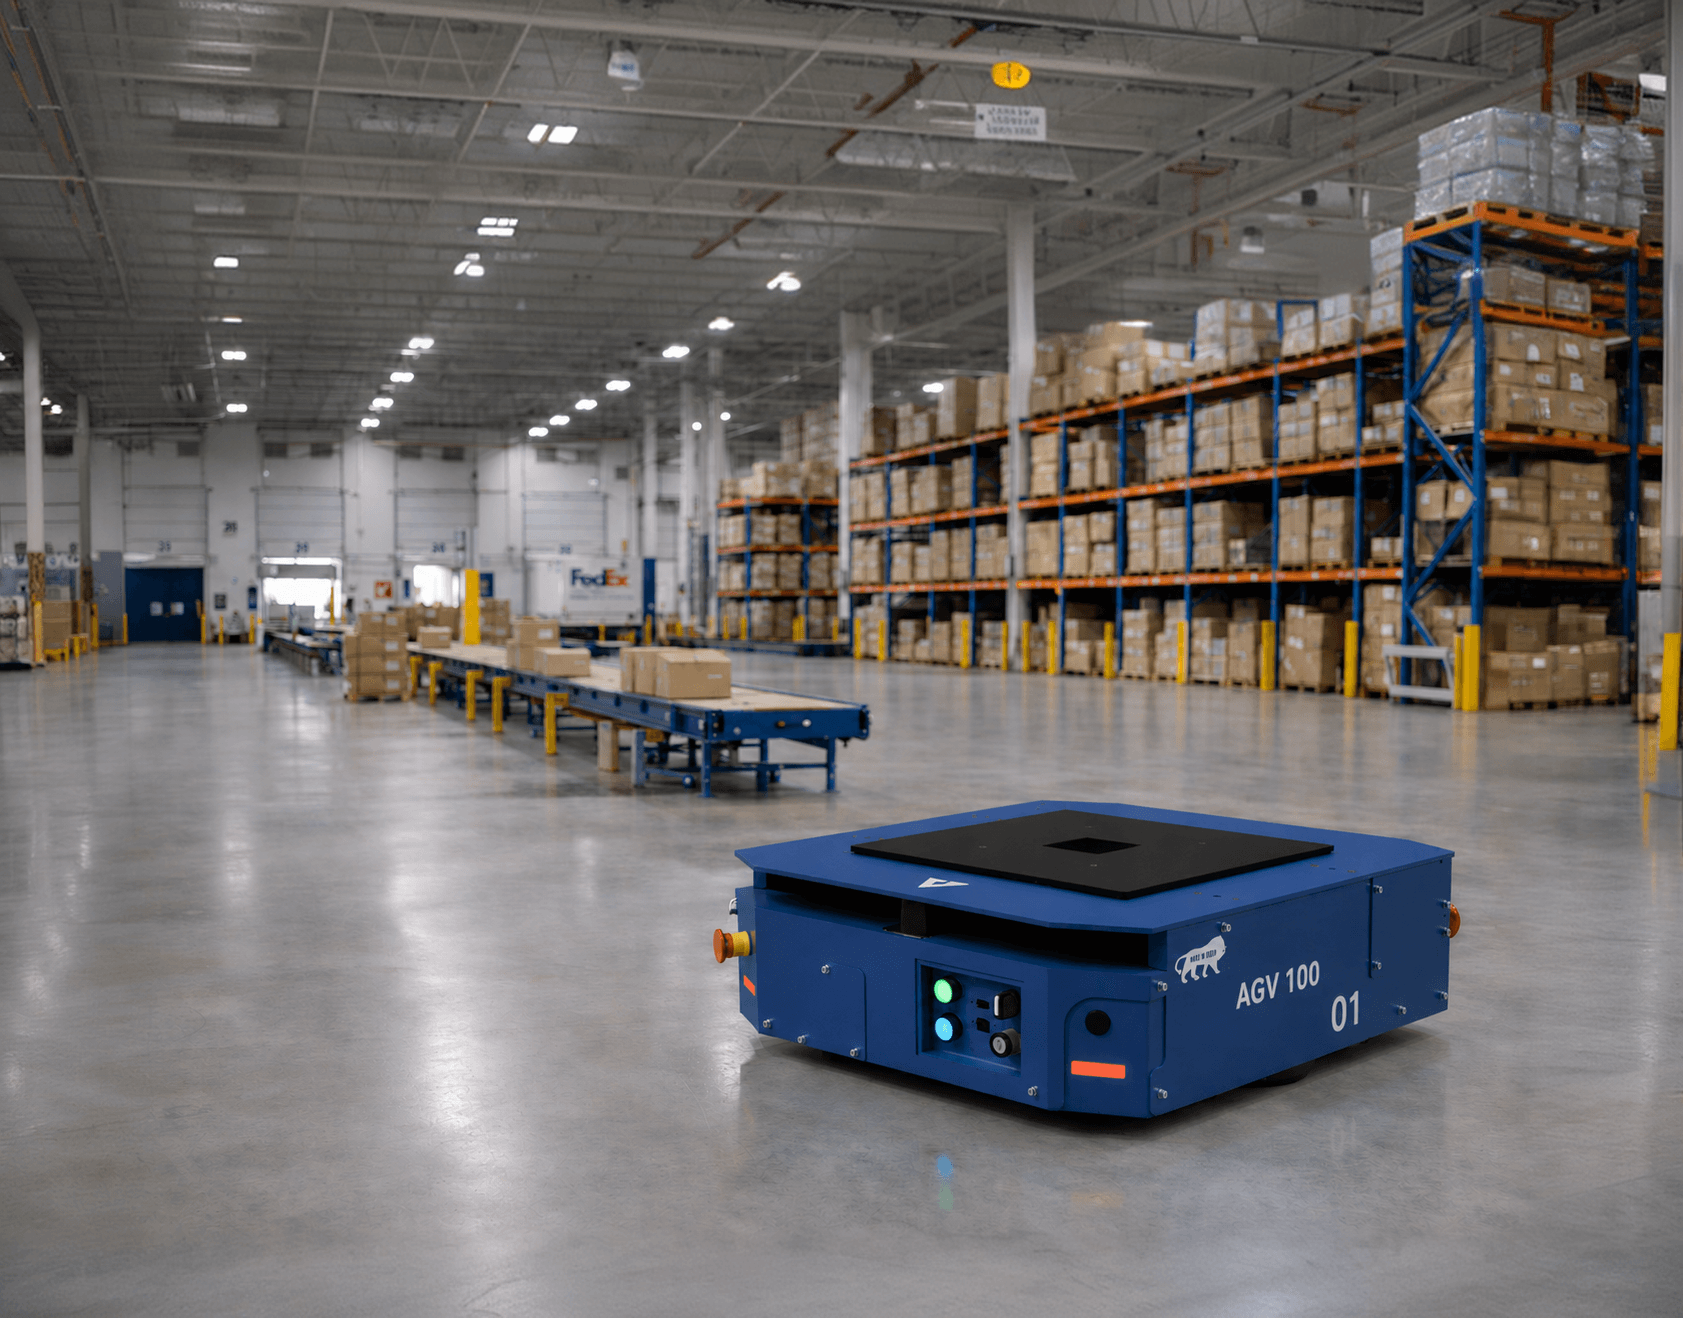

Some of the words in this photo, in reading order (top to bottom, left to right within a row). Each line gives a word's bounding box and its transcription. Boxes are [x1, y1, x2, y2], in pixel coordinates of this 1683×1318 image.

[571, 568, 629, 587] FedEx
[1236, 972, 1280, 1010] AGV
[1286, 960, 1320, 993] 100
[1331, 990, 1359, 1032] 01
